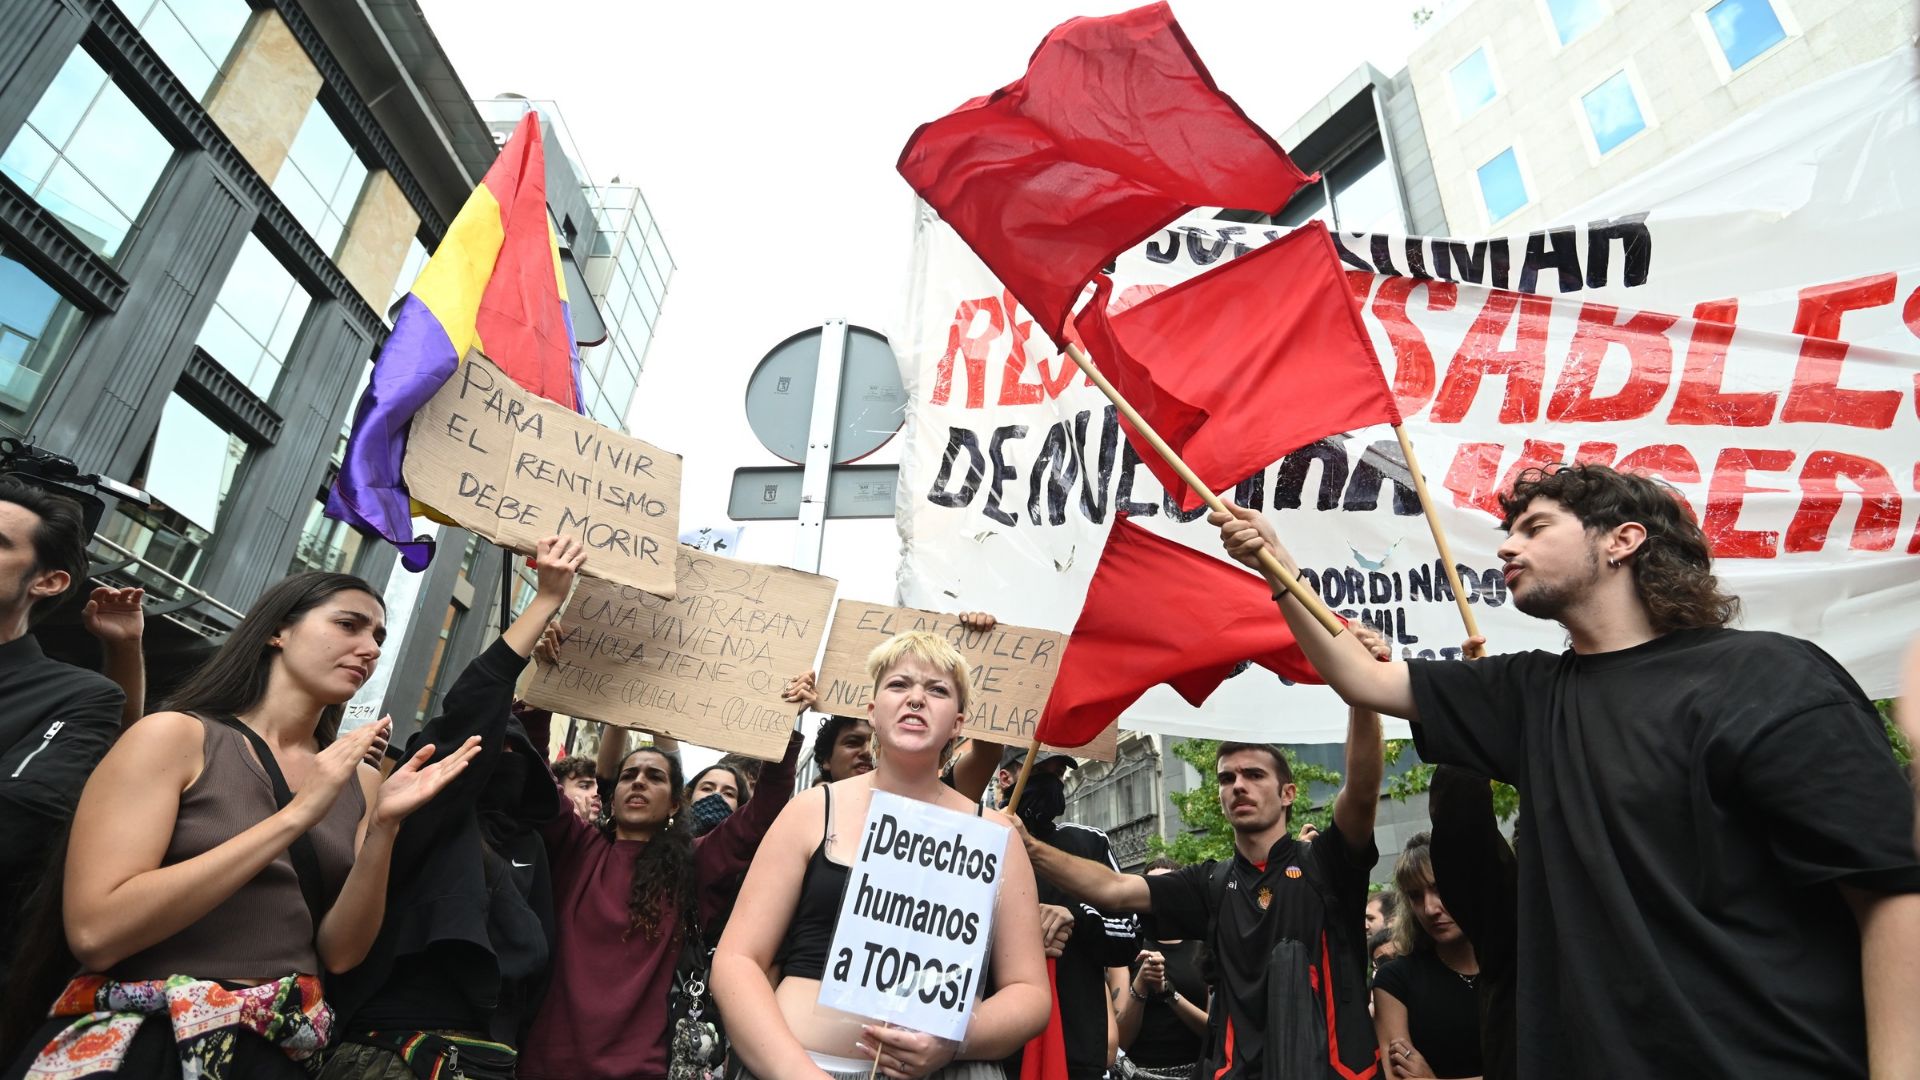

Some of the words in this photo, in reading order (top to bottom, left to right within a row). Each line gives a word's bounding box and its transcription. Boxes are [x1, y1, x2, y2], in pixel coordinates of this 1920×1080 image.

[460, 361, 543, 440] PARA
[574, 430, 657, 479] VIVIR
[446, 413, 488, 454] EL
[515, 452, 668, 518] RENTISMO
[458, 472, 542, 527] DEBE
[556, 506, 660, 565] MORIR
[714, 568, 765, 604] 21
[560, 625, 646, 665] AHORA
[656, 647, 738, 683] TIENE
[580, 595, 638, 630] UNA
[651, 612, 776, 669] VIVIENDA
[856, 610, 897, 636] EL
[543, 660, 614, 698] MORIR
[622, 678, 689, 714] QUIEN
[721, 696, 792, 734] QUIERES
[861, 813, 997, 884] ¡Derechos
[853, 872, 980, 945] humanos
[832, 946, 853, 983] a
[860, 941, 973, 1013] TODOS!
